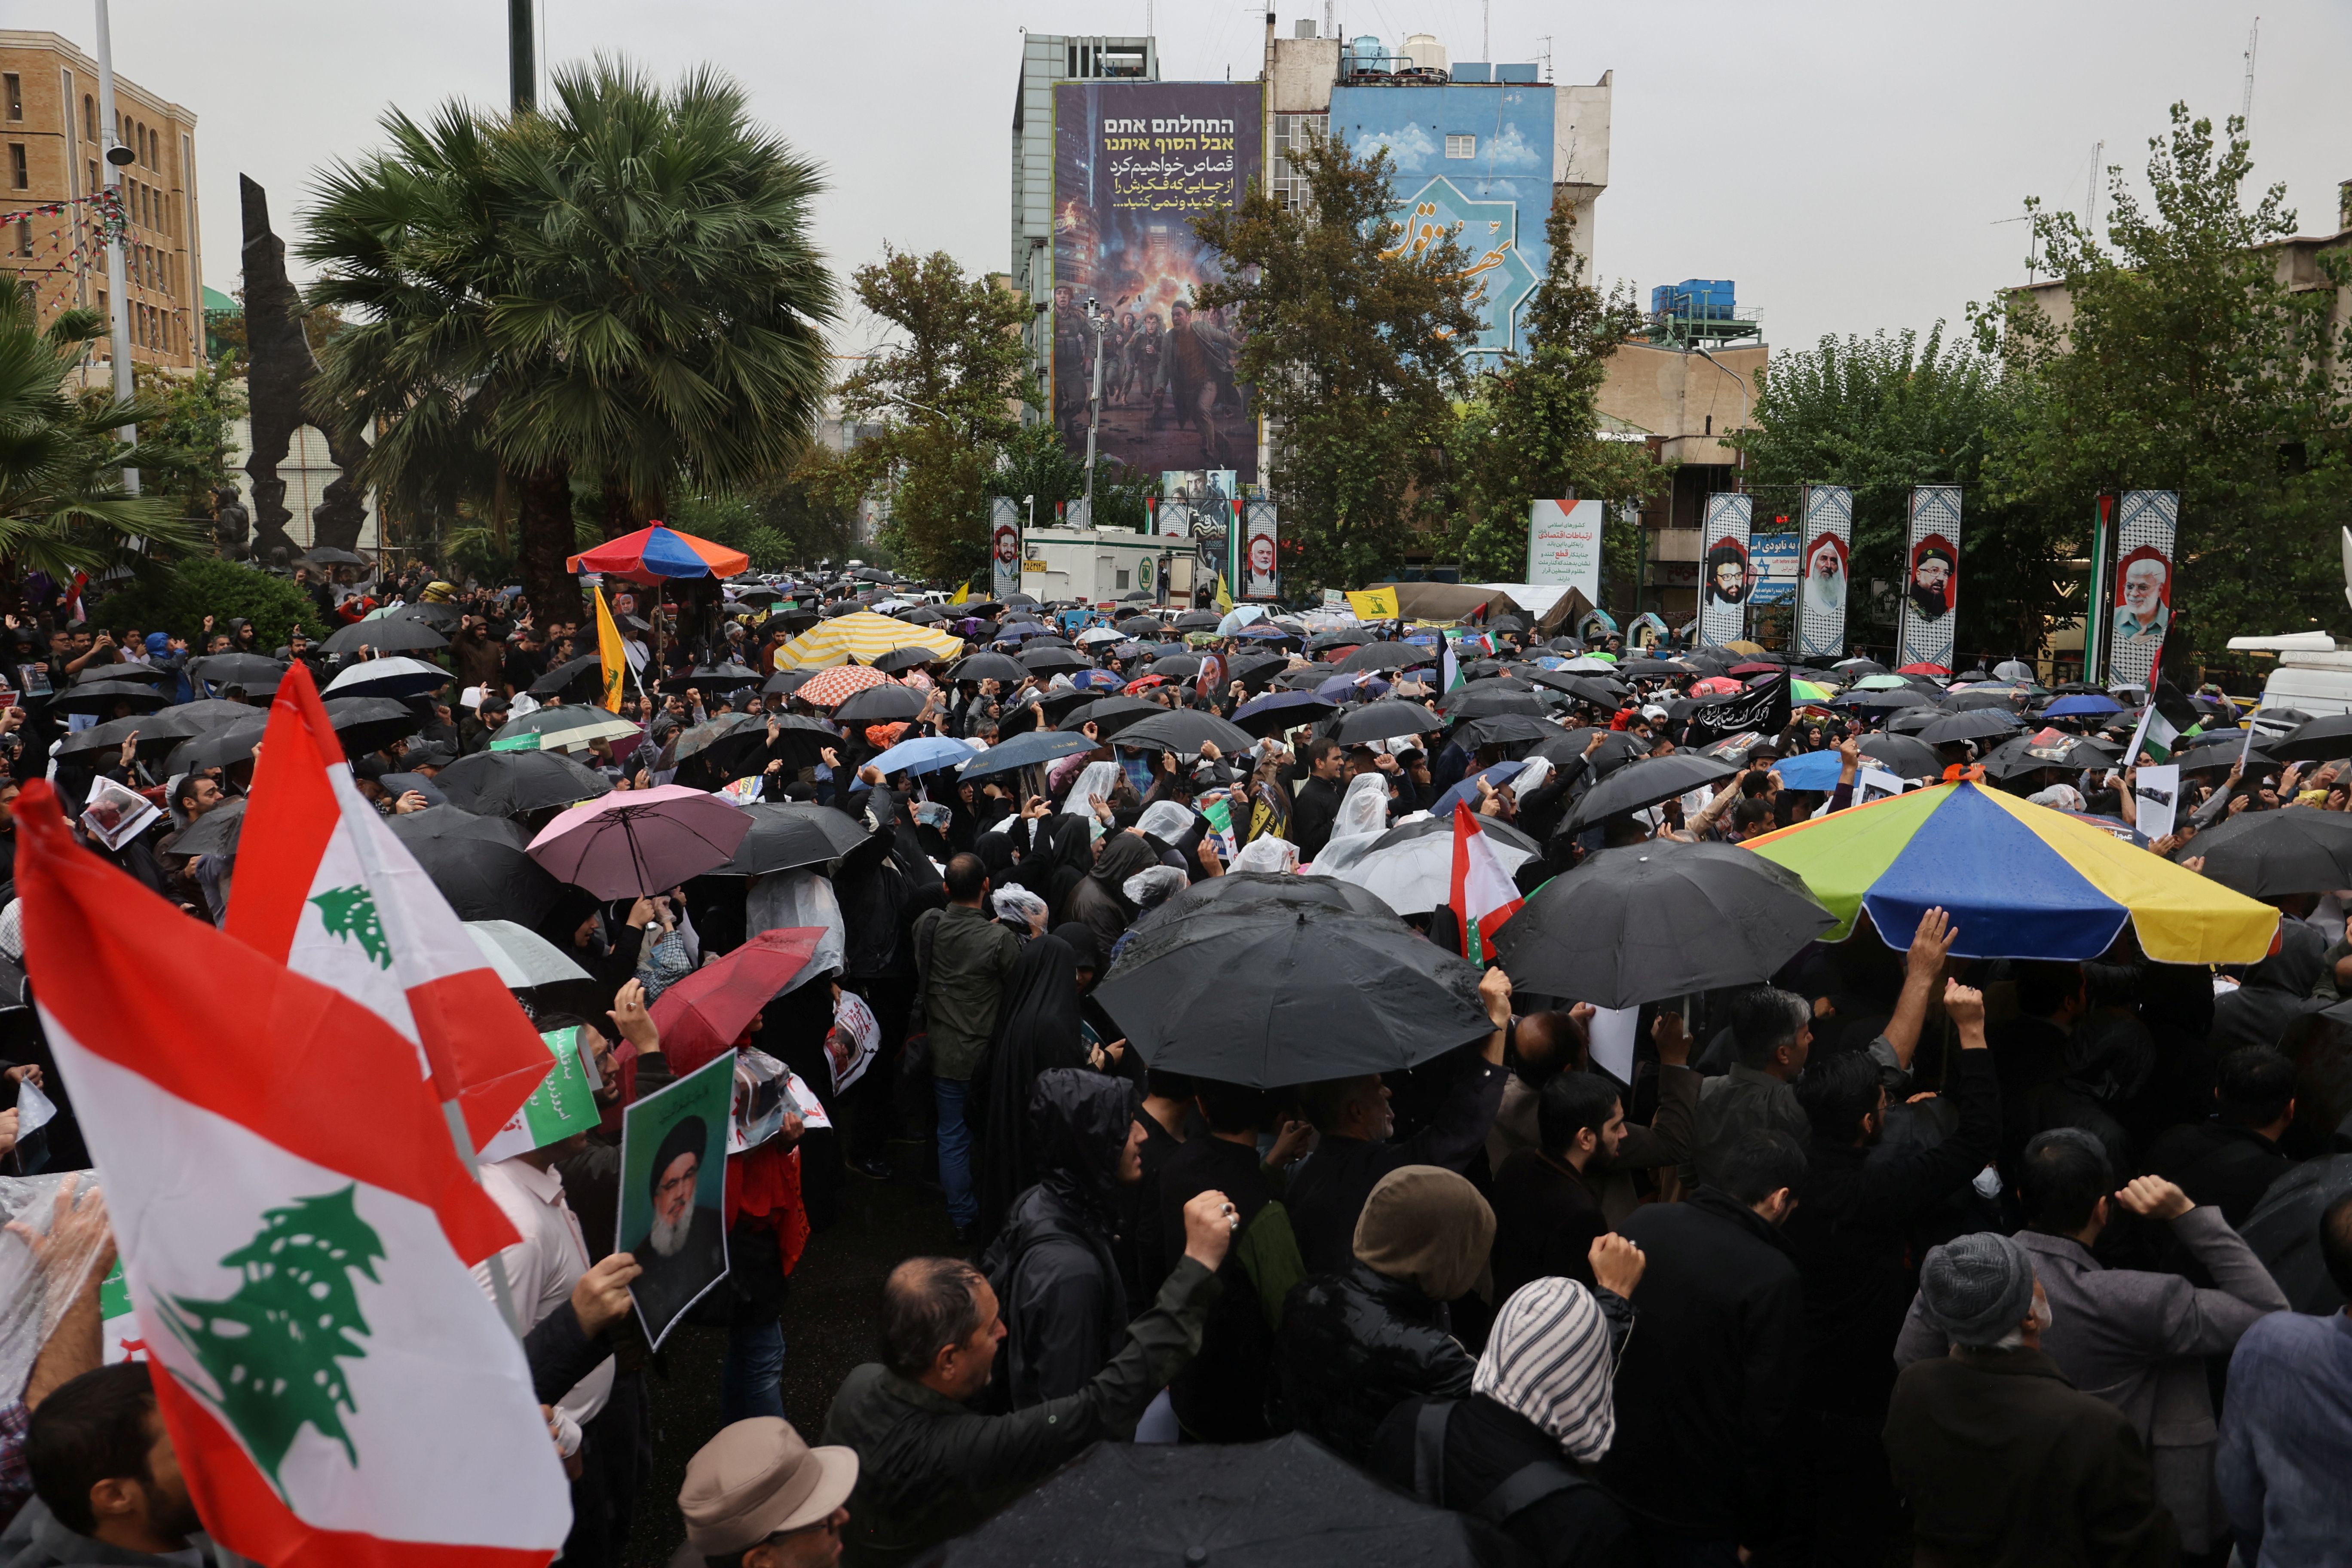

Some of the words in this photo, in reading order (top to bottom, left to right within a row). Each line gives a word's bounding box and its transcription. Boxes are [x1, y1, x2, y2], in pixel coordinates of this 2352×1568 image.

[1104, 119, 1147, 133] אתם
[1152, 114, 1234, 133] התחלתם
[1104, 138, 1150, 150] איתנו
[1155, 138, 1196, 154] הסוף
[1201, 134, 1234, 150] אבל
[1110, 156, 1133, 176] کرد
[1131, 156, 1184, 179] خواهیم
[1184, 156, 1233, 177] قصاص
[1115, 177, 1121, 194] را
[1123, 177, 1170, 194] فکرش
[1170, 177, 1185, 190] که
[1184, 177, 1224, 194] جایی
[1223, 177, 1234, 193] از
[1538, 531, 1565, 539] اقتصادی
[1565, 532, 1592, 541] ارتباطات
[1555, 549, 1568, 559] قطع
[1762, 539, 1787, 554] نابودی
[550, 1092, 571, 1120] امروز
